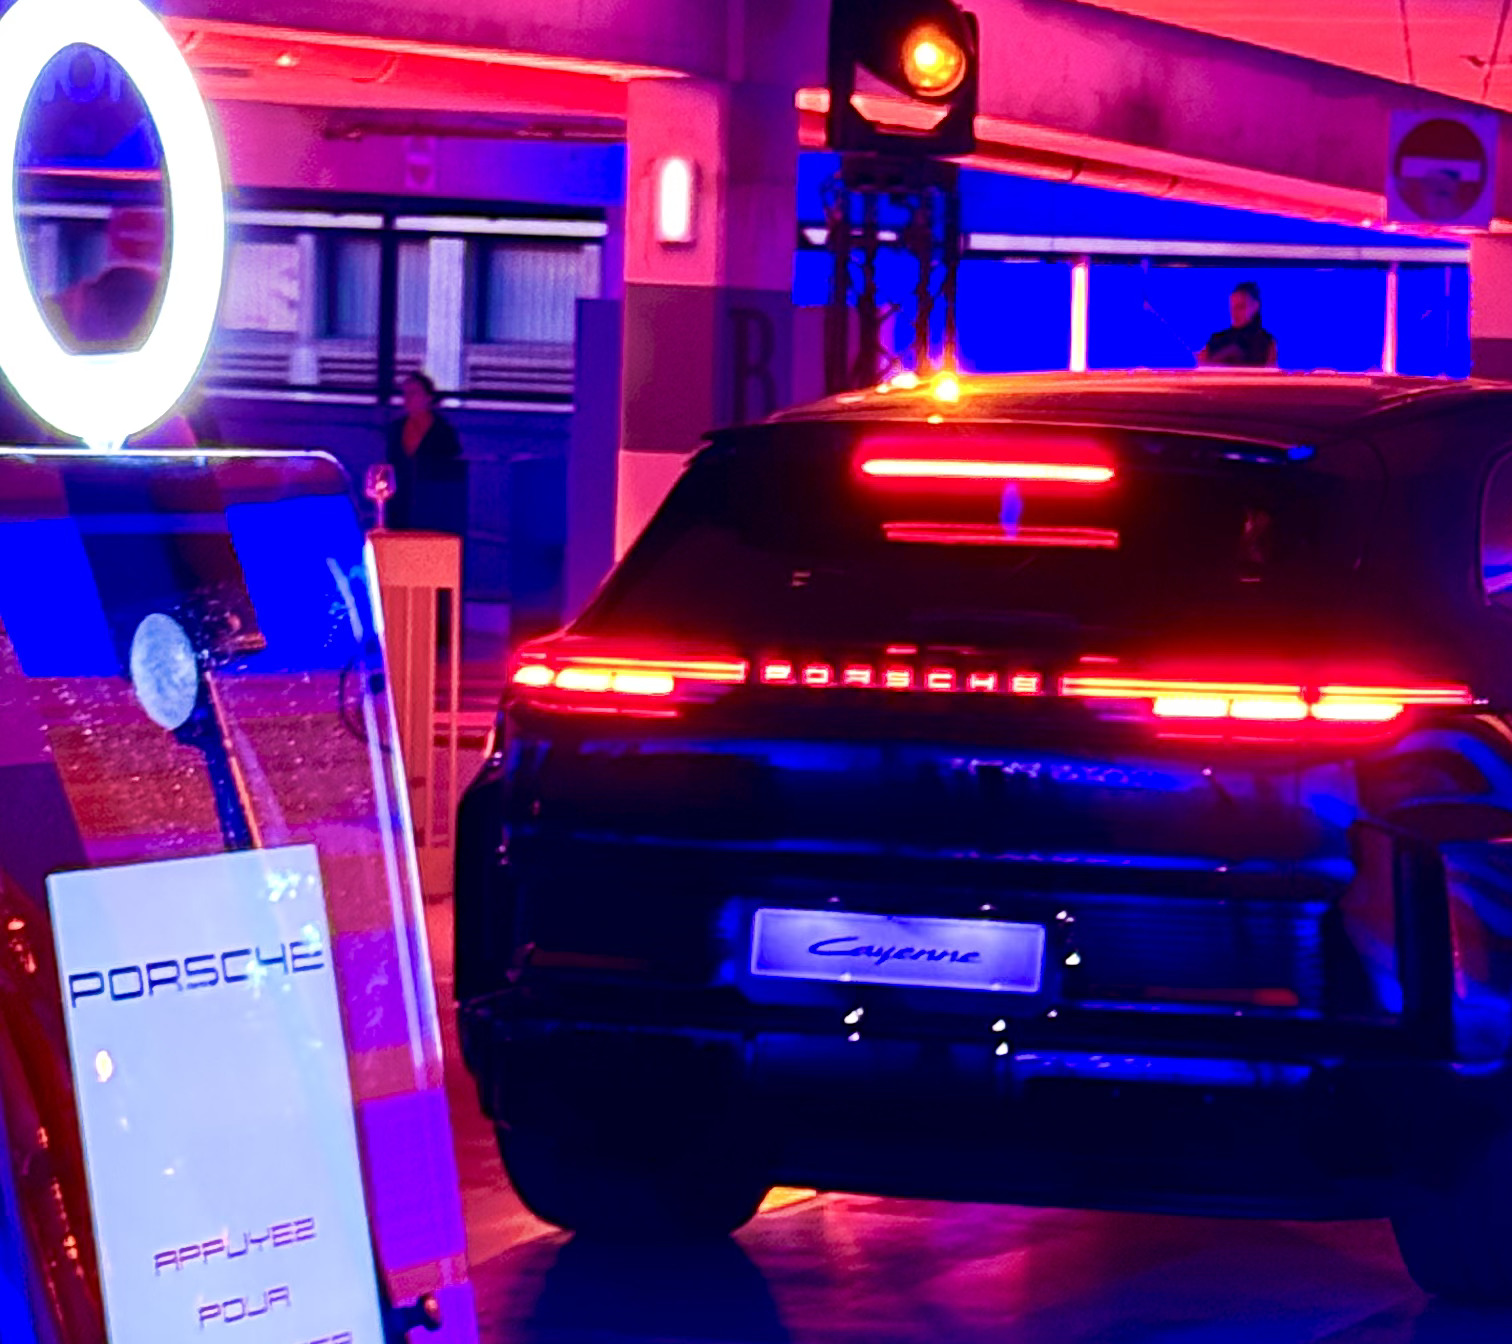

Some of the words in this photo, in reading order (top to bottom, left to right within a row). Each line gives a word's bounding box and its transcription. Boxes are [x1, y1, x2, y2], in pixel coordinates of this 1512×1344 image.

[763, 662, 1042, 694] PORSCHE
[808, 936, 981, 965] Cayenne
[68, 941, 325, 1008] PORSCHE
[154, 1217, 316, 1277] APPUYEZ
[199, 1285, 291, 1331] POUR
